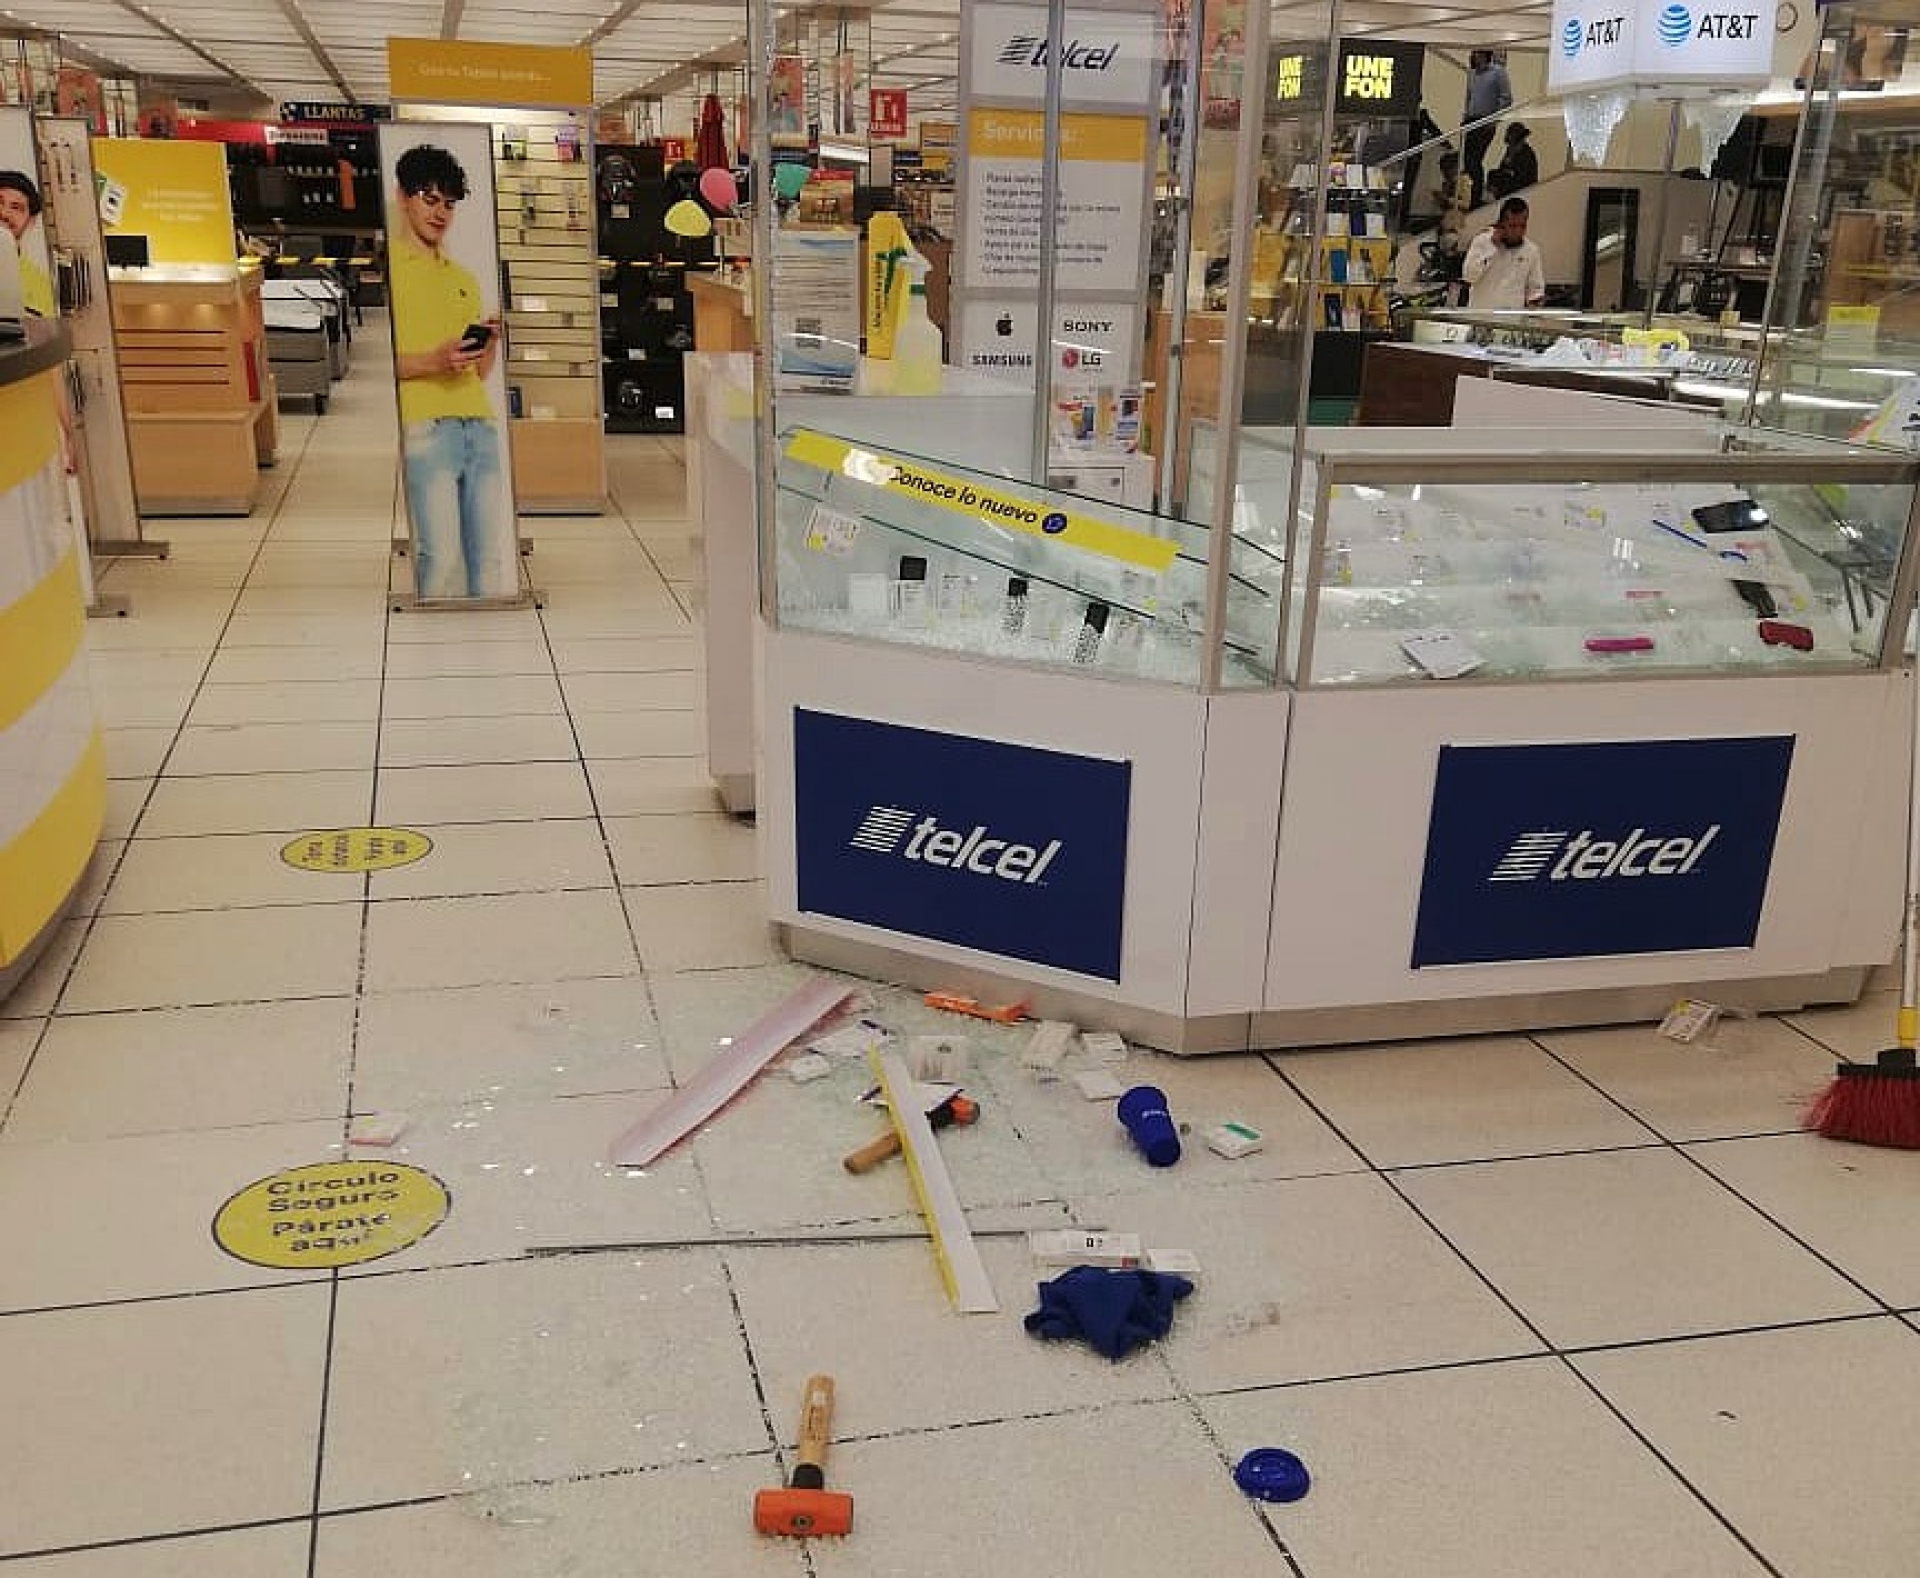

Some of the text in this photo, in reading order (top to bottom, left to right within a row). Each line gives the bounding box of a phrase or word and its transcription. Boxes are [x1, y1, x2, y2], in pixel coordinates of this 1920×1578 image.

[1586, 18, 1625, 47] AT&T
[1697, 14, 1759, 40] AT&T
[1030, 39, 1119, 70] tlcel
[1346, 54, 1394, 77] UNE
[1279, 55, 1303, 77] UNE
[1278, 78, 1302, 99] FON
[1343, 77, 1392, 99] FON
[303, 105, 367, 120] LLANTAS
[1063, 321, 1112, 332] SONY
[973, 354, 1033, 367] SAMSUNG
[1081, 353, 1102, 366] LG
[957, 486, 977, 506] lo
[979, 497, 1038, 524] nuevo
[904, 817, 1063, 883] telcel
[1550, 824, 1721, 880] telcel
[268, 1190, 399, 1212] Seguro
